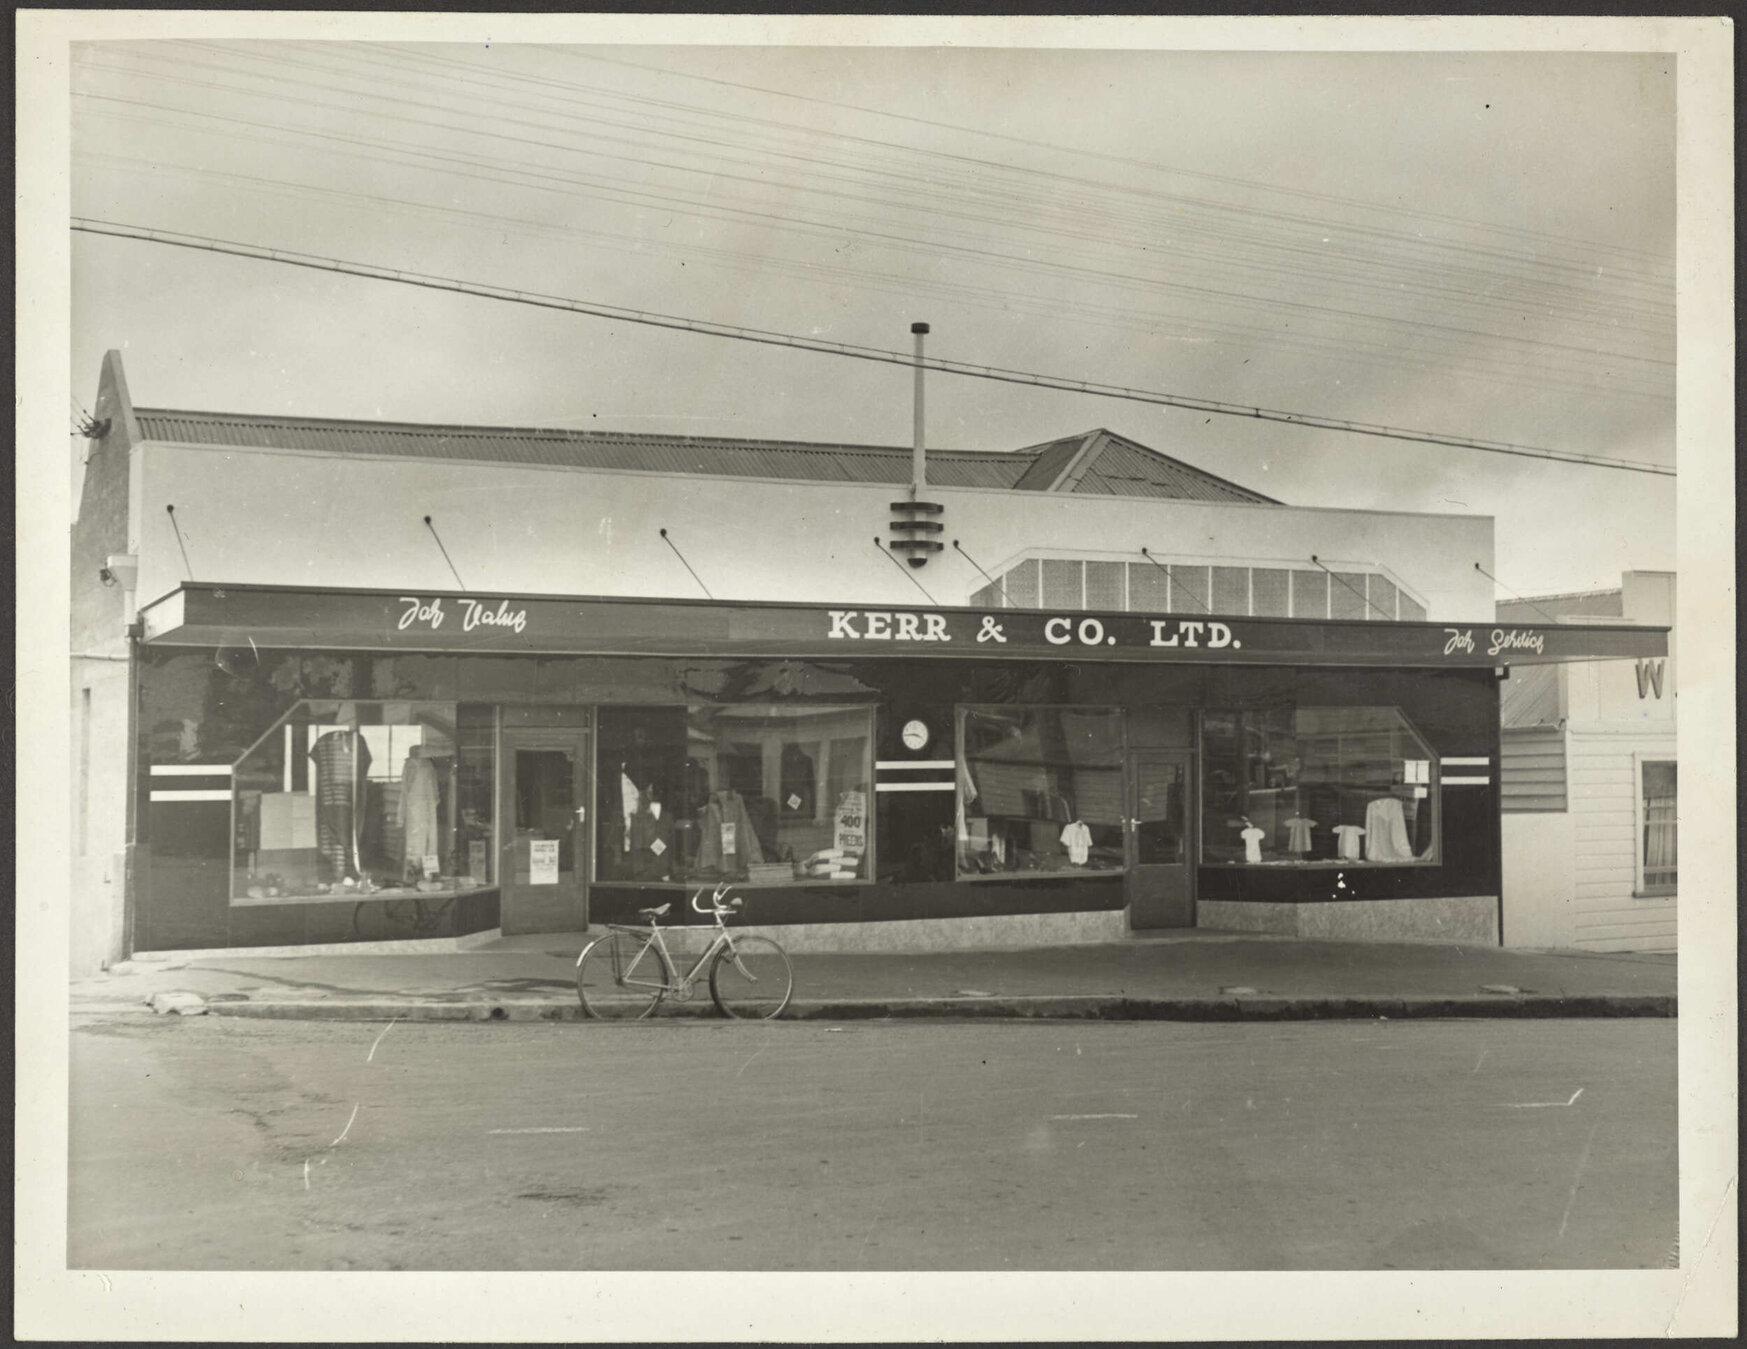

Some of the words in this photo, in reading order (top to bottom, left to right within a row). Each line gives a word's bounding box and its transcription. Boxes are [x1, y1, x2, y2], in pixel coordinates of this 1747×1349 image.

[457, 599, 527, 633] Value
[827, 610, 952, 642] KERR
[976, 615, 1007, 644] &
[1044, 618, 1117, 646] CO.
[1150, 620, 1242, 649] LTD.
[1487, 628, 1544, 656] Service
[840, 815, 861, 828] 400
